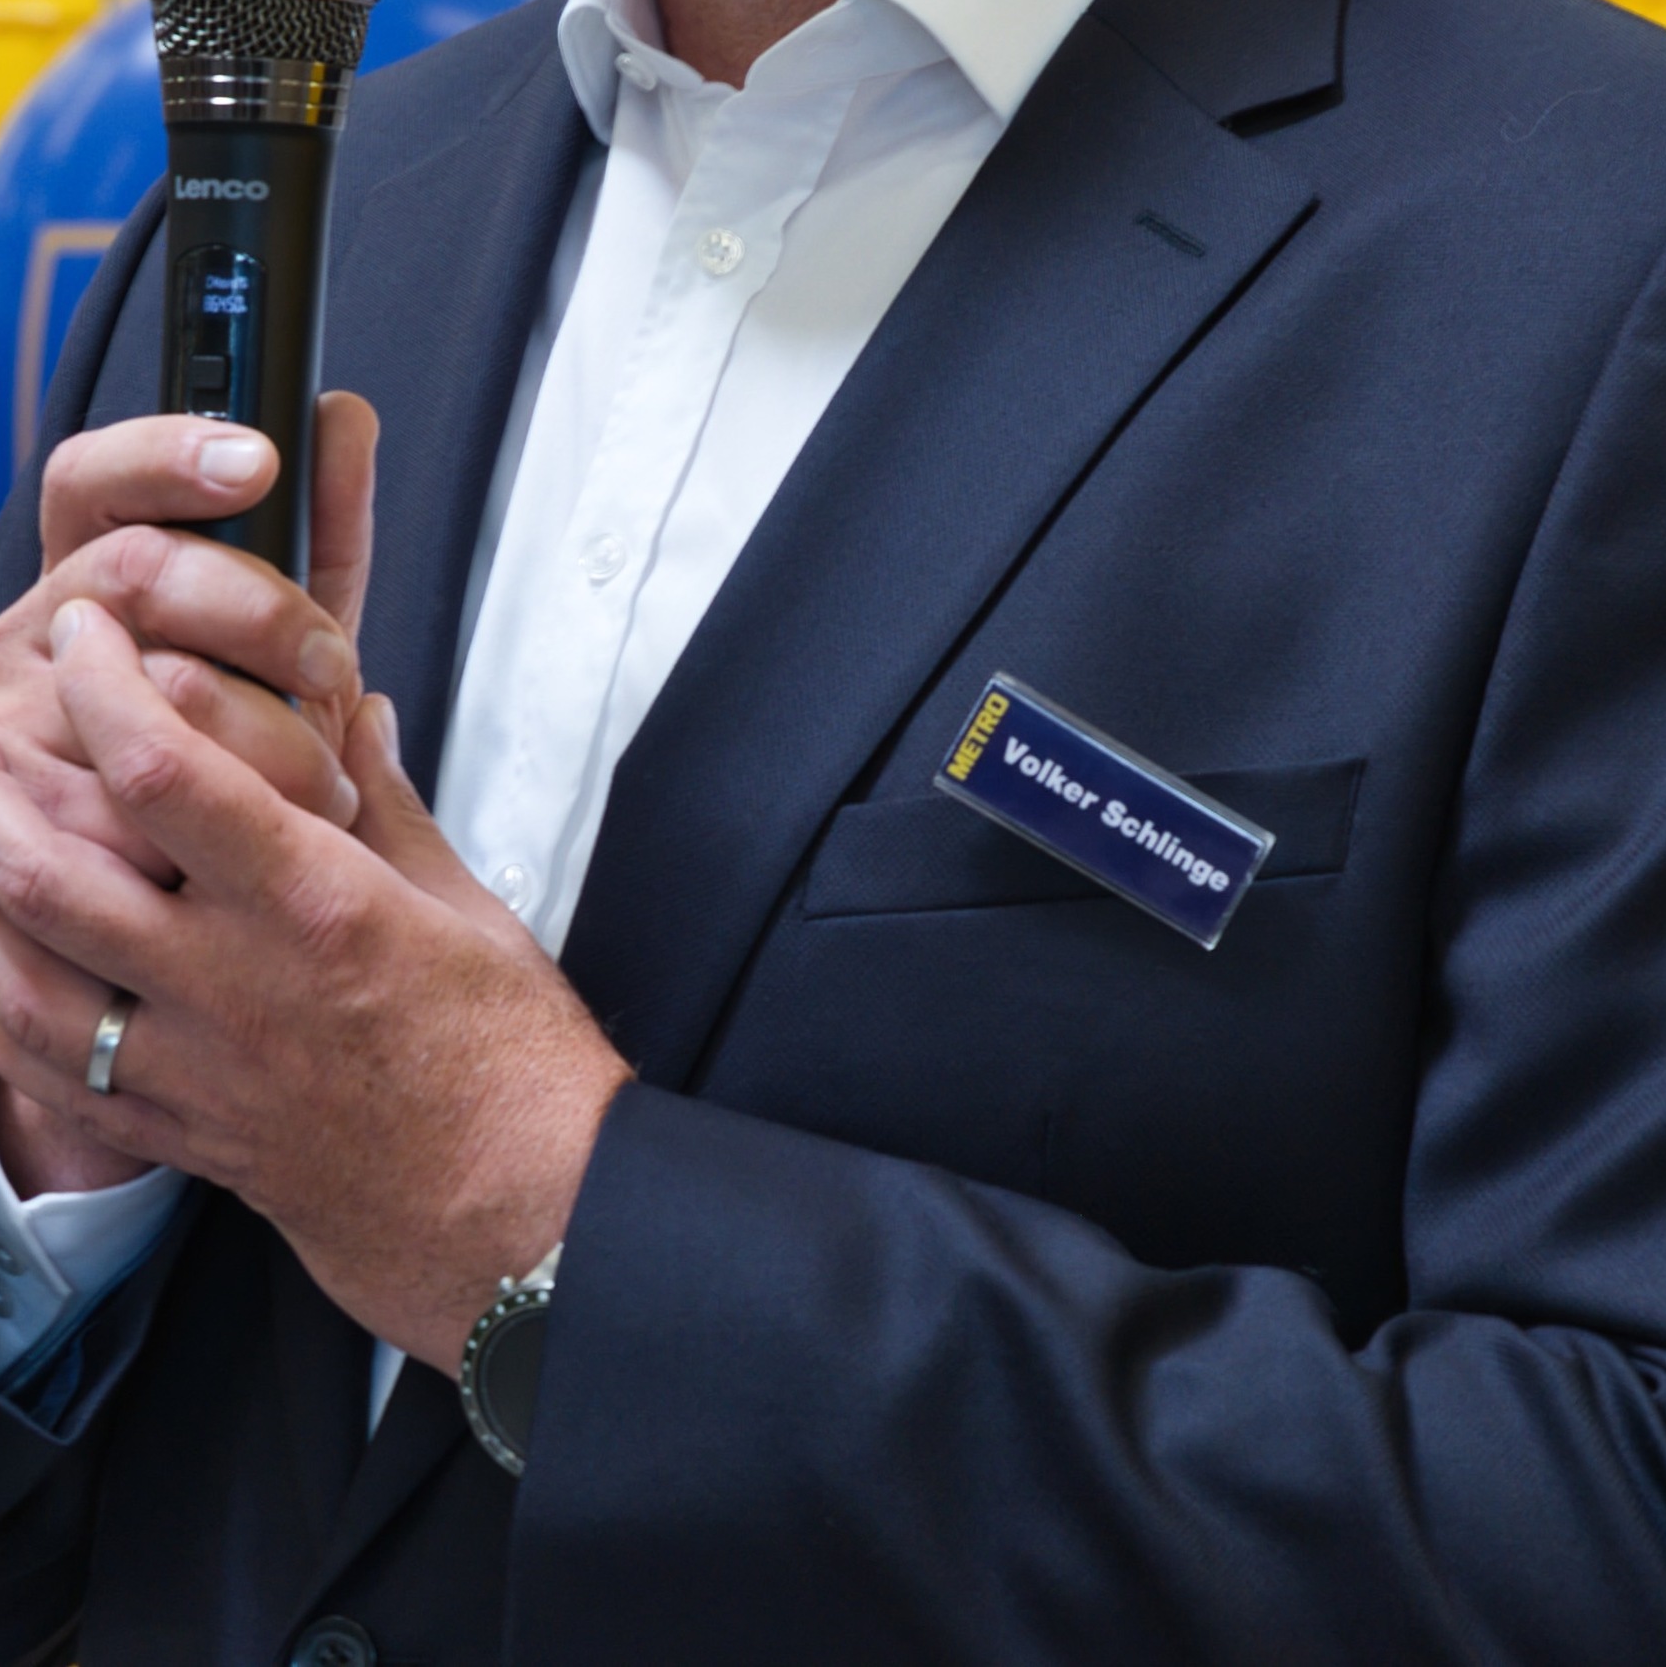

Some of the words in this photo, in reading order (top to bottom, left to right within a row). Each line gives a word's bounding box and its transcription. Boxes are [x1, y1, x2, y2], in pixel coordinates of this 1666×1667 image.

[175, 175, 270, 201] Lenco
[946, 692, 1010, 781] METRO
[1003, 737, 1099, 810] Volker
[1100, 800, 1230, 892] Schlinge
